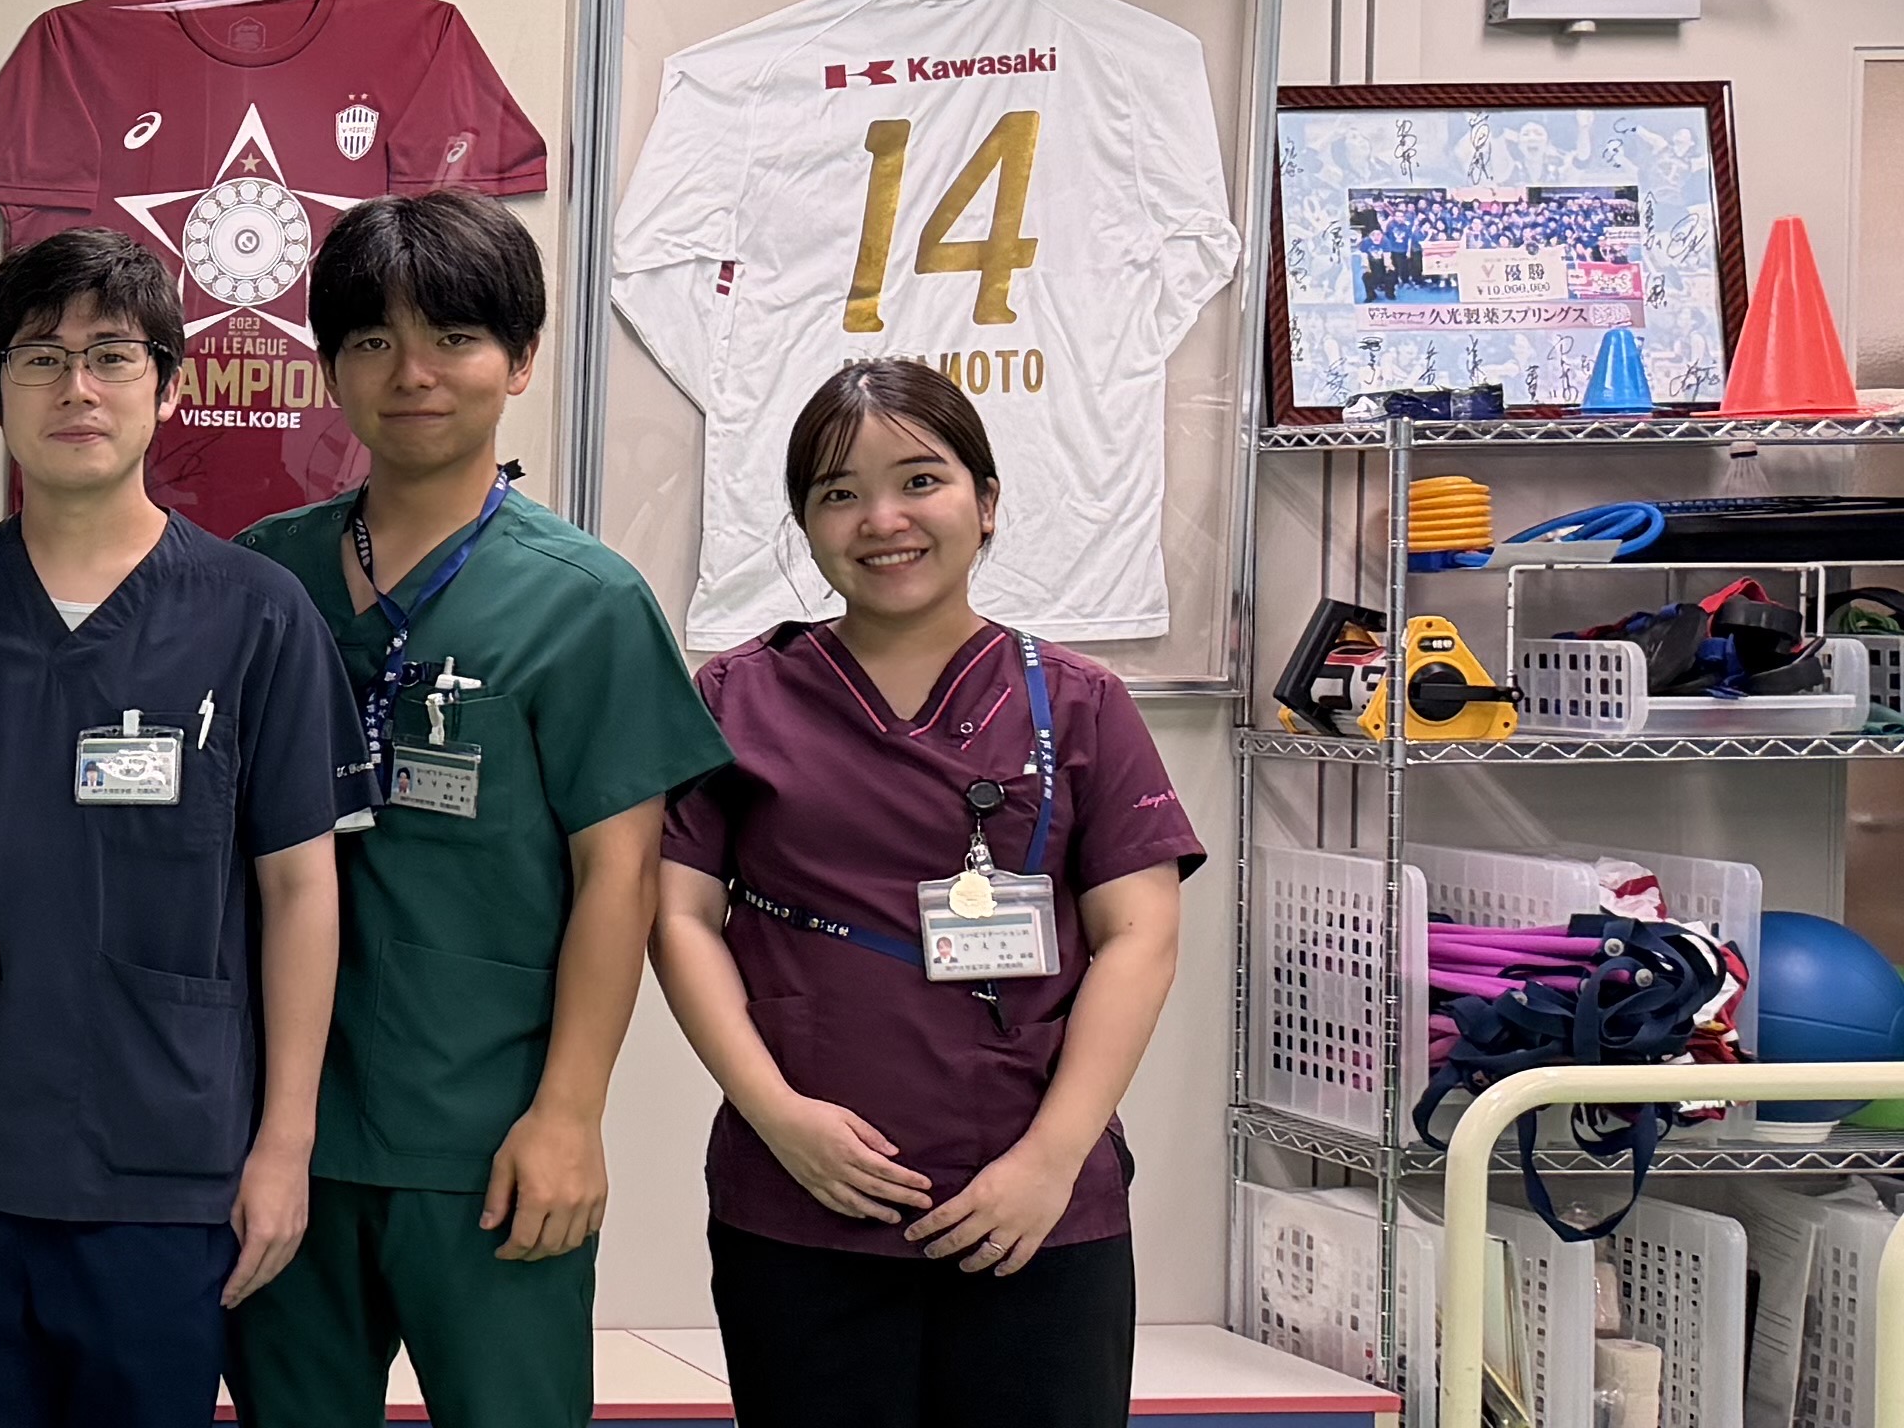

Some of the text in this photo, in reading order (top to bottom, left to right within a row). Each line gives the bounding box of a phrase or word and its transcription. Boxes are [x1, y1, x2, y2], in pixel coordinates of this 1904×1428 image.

[907, 47, 1058, 83] Kawasaki
[842, 110, 1040, 334] 14
[228, 317, 261, 330] 2023
[222, 337, 289, 356] LEAGUE
[179, 408, 302, 429] VISSEL KOBE
